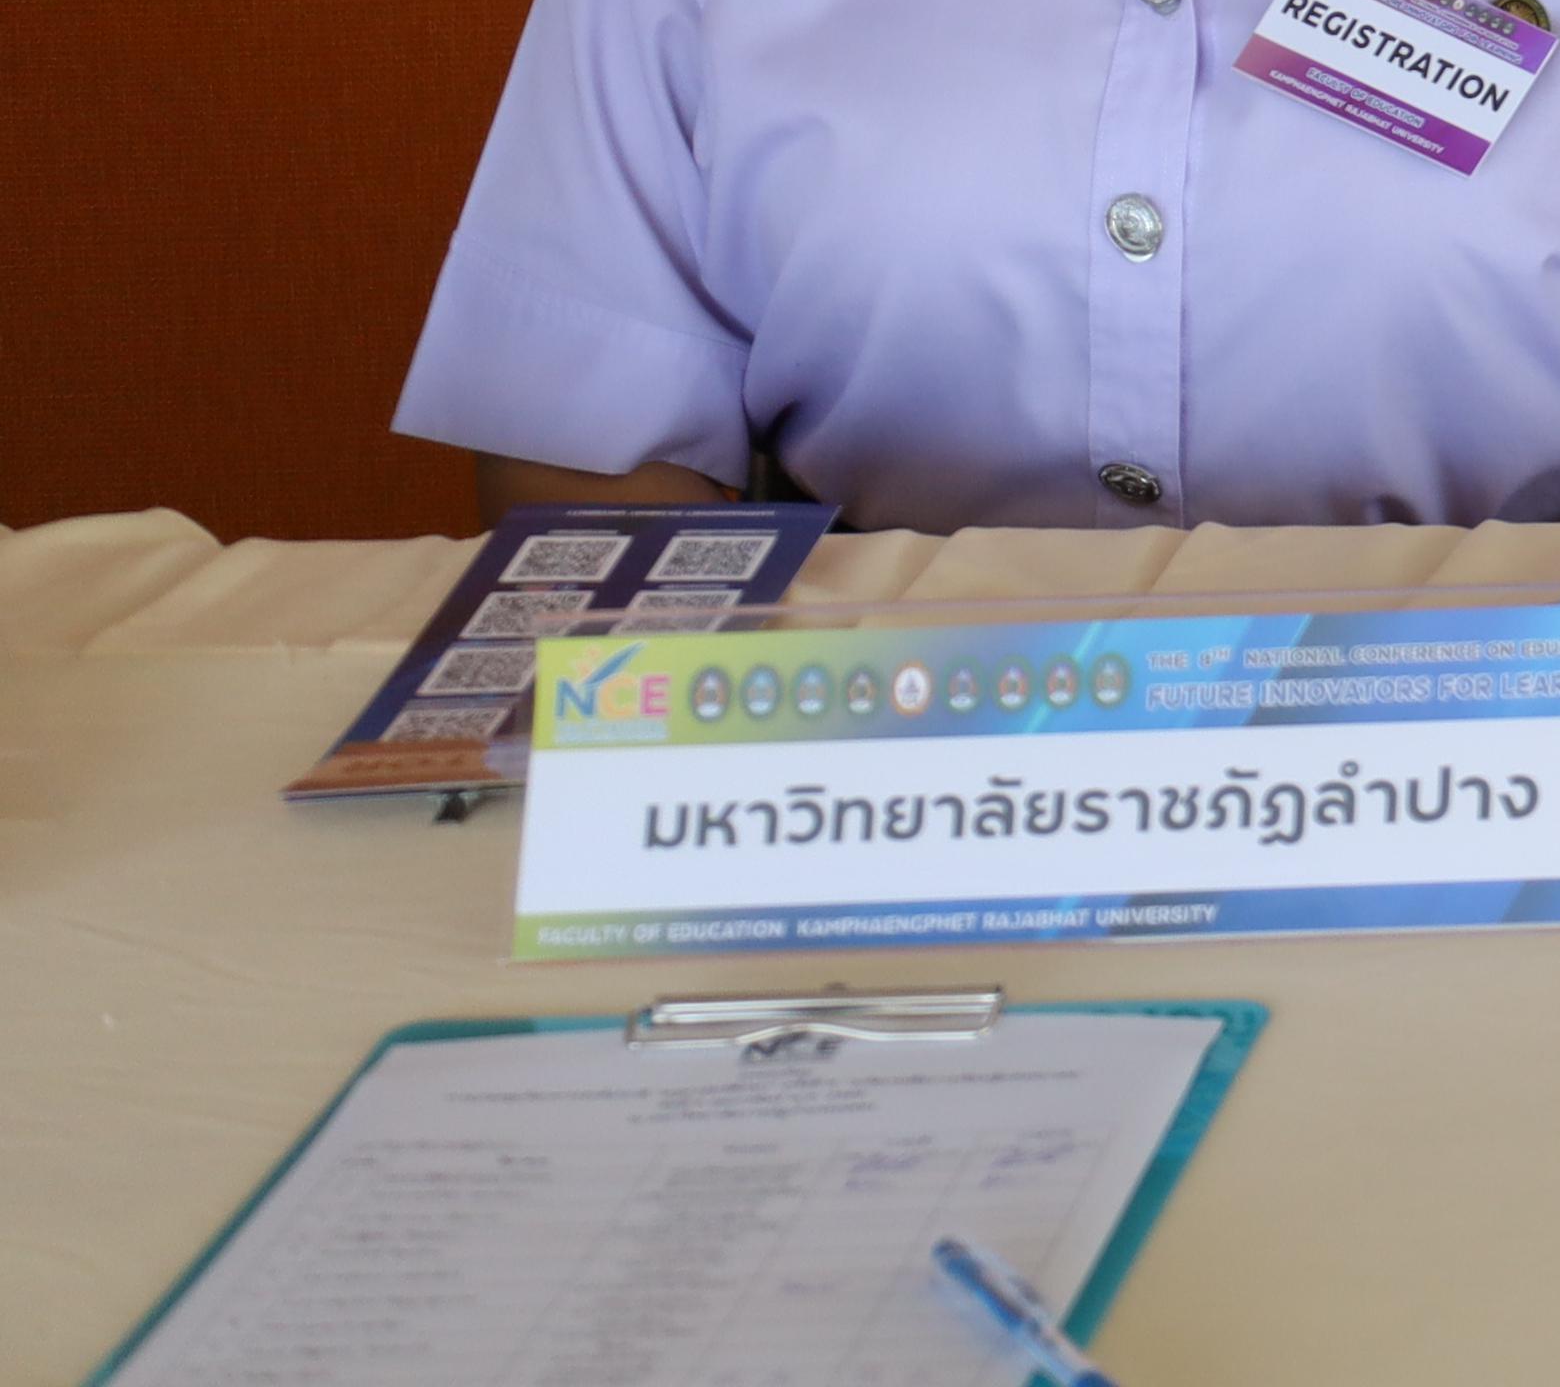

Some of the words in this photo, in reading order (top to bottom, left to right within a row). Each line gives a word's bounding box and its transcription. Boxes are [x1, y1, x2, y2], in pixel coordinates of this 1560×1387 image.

[1244, 645, 1344, 668] NATIONAL
[1350, 640, 1480, 664] CONFERENCE
[1486, 639, 1516, 659] ON
[556, 674, 671, 720] NCE
[1147, 681, 1252, 710] FUTURE
[1260, 674, 1431, 708] INNOVATORS
[1438, 673, 1493, 702] FOR
[644, 760, 1540, 850] มหาวิทยาลัยราชภัฏลำปาง
[633, 924, 662, 944] OF
[667, 920, 785, 943] EDUCATION
[797, 911, 975, 938] KAMPHAENGPHET
[982, 908, 1091, 931] RAJABHAT
[1096, 904, 1219, 927] UNIVERSITY
